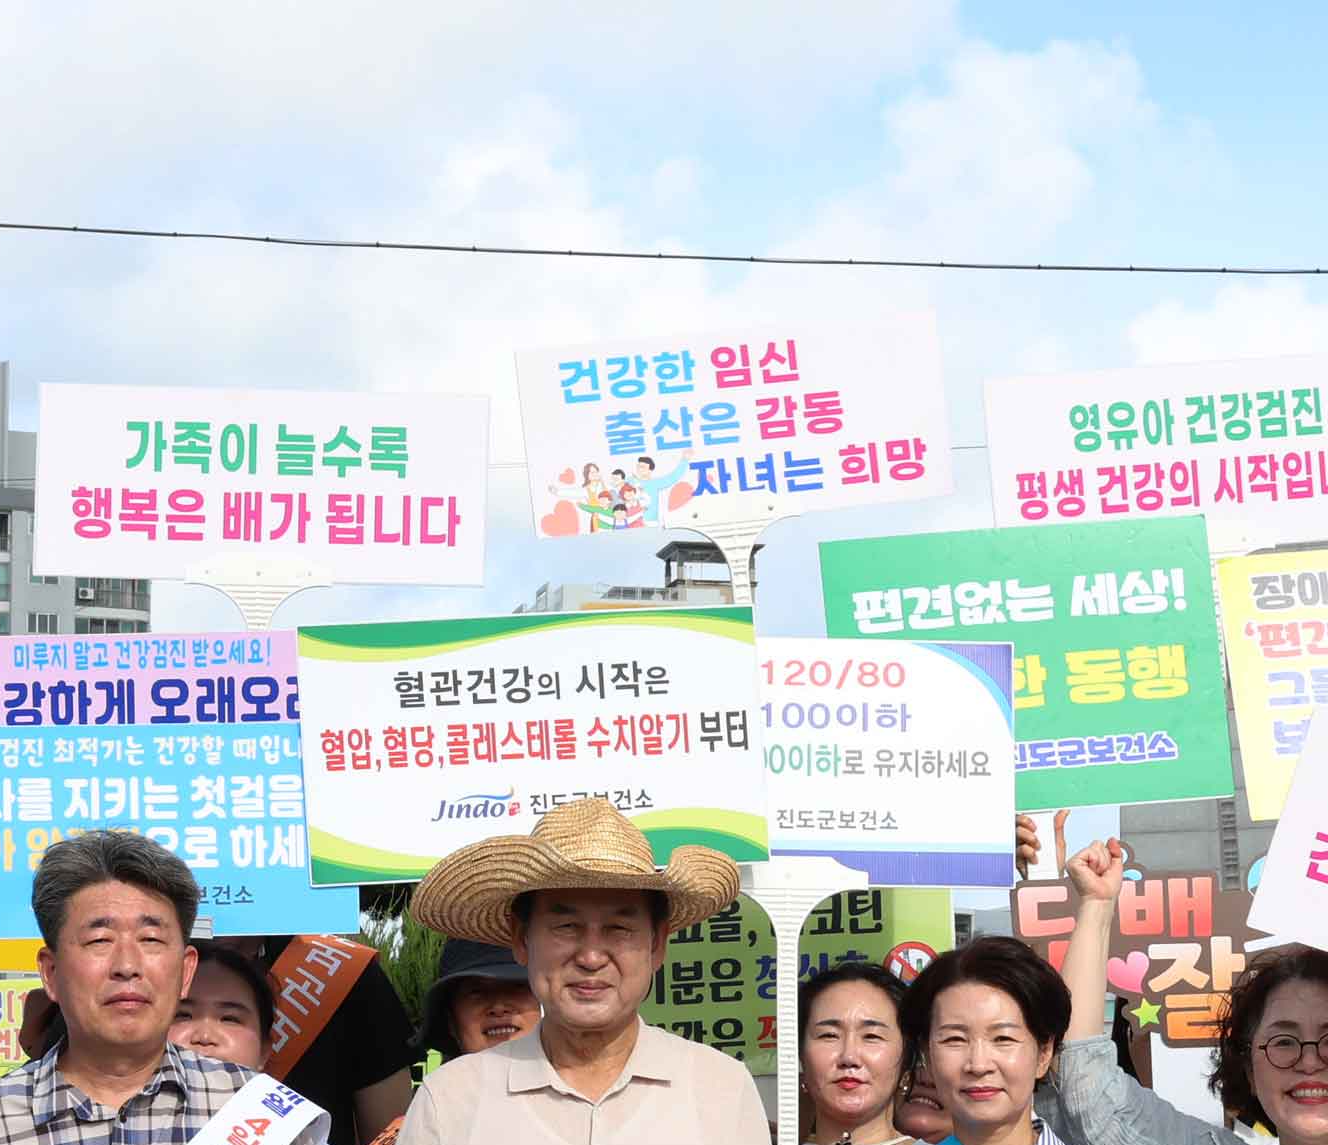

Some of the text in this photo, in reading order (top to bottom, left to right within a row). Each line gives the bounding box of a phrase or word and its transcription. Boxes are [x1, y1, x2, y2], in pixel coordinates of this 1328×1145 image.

[557, 339, 801, 404] 건강한 임신
[603, 390, 845, 456] 출산은 감동
[1068, 387, 1324, 453] 영유아 건강검진
[125, 420, 409, 479] 가족이 늘수록
[688, 437, 927, 497] 자녀는 희망
[71, 486, 461, 547] 행복은 배가 됩니다
[1015, 467, 1086, 521] 평생
[1096, 459, 1201, 515] 건강의
[851, 568, 1186, 633] 편견없는 세상!
[14, 638, 271, 671] 미루지 말고 건강검진 받으세요!
[1065, 645, 1190, 705] 동행
[394, 660, 670, 709] 혈관건강의 시작은
[54, 735, 145, 766] 최적기는
[153, 736, 224, 765] 건강할
[587, 712, 690, 758] 수치알기
[700, 709, 749, 753] 부터
[874, 749, 992, 778] 유지하세요
[63, 775, 178, 820] 지키는
[191, 774, 303, 819] 첫걸음
[432, 799, 506, 822] Jindo
[776, 809, 898, 831] 진도군보건소
[230, 824, 304, 868] 하세
